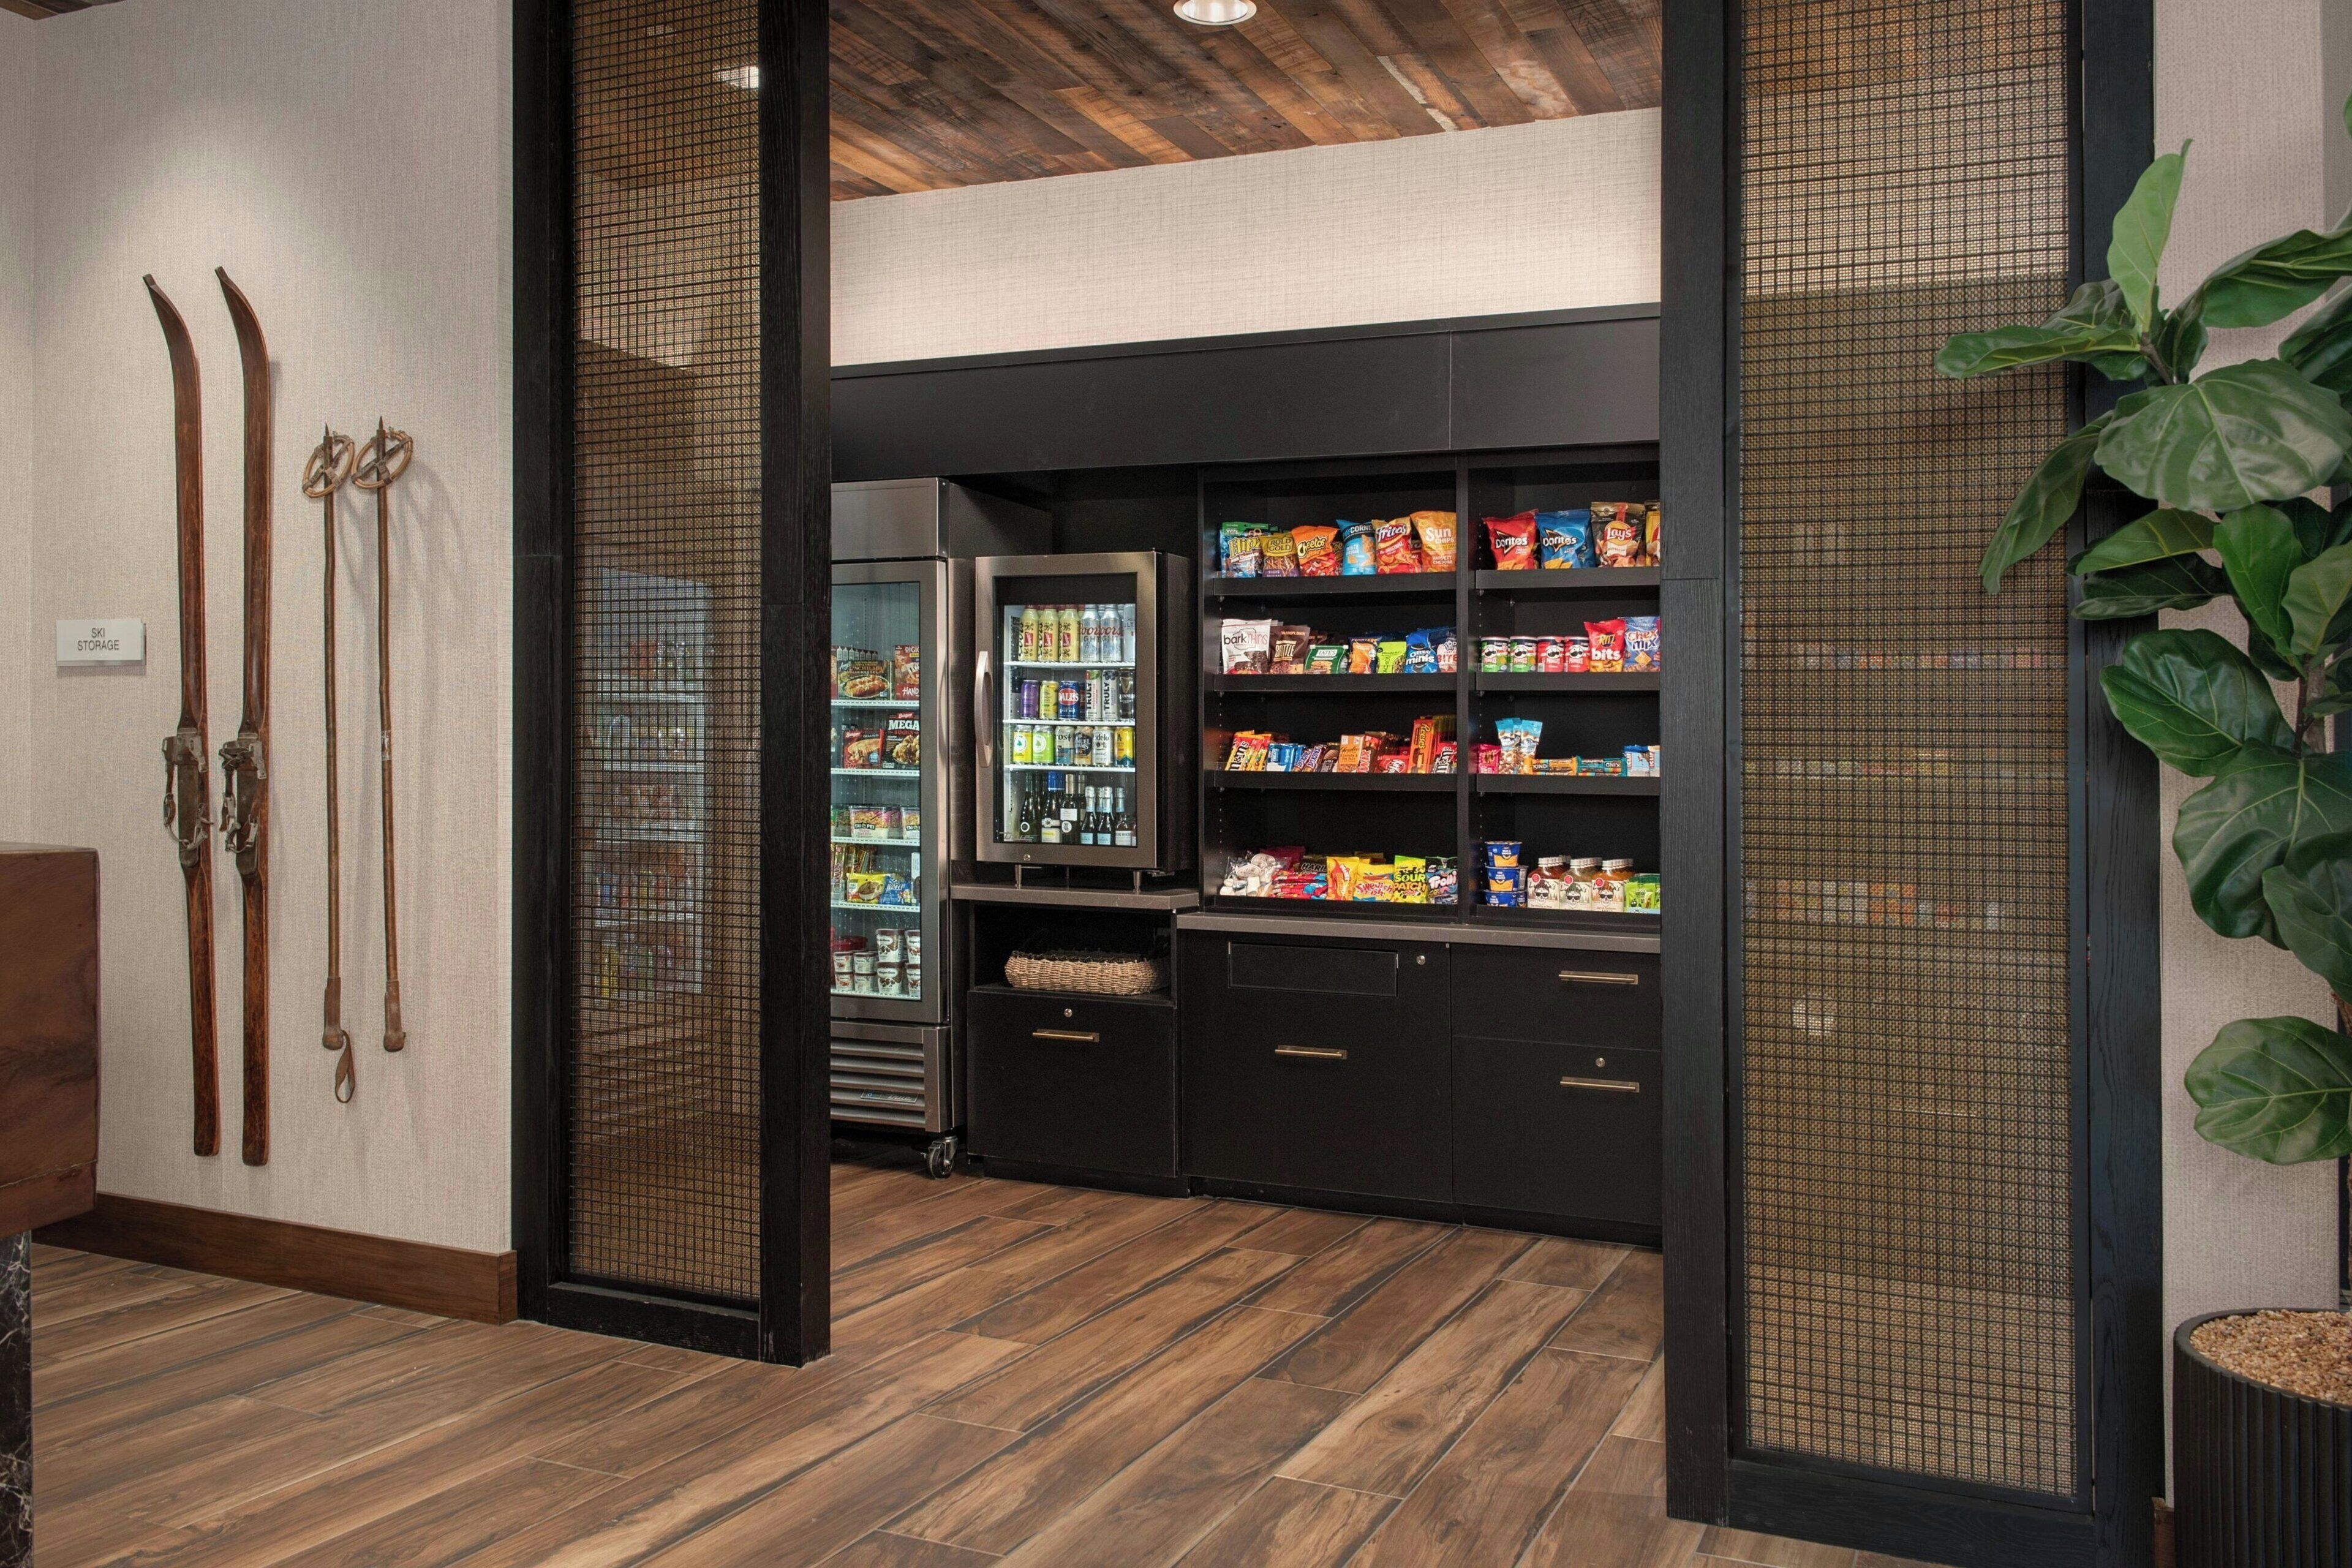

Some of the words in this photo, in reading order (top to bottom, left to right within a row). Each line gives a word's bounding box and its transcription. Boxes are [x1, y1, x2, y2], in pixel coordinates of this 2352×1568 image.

[1376, 524, 1407, 542] Fritos
[1425, 527, 1452, 541] Sun
[1607, 527, 1632, 541] Lay's
[1297, 537, 1327, 557] Cheetos
[1496, 536, 1529, 549] Doritos
[1543, 537, 1577, 547] Doritos
[91, 628, 105, 638] SKI
[77, 639, 119, 651] STORAGE
[1405, 654, 1434, 666] minis
[1591, 648, 1621, 660] bits
[888, 720, 920, 731] MEGA
[1419, 723, 1430, 750] Reese's
[1301, 863, 1327, 872] HARI
[1395, 874, 1426, 883] SOUR
[1428, 870, 1457, 889] Trolli
[1356, 882, 1393, 893] Swedish
[1393, 882, 1427, 892] PATCH
